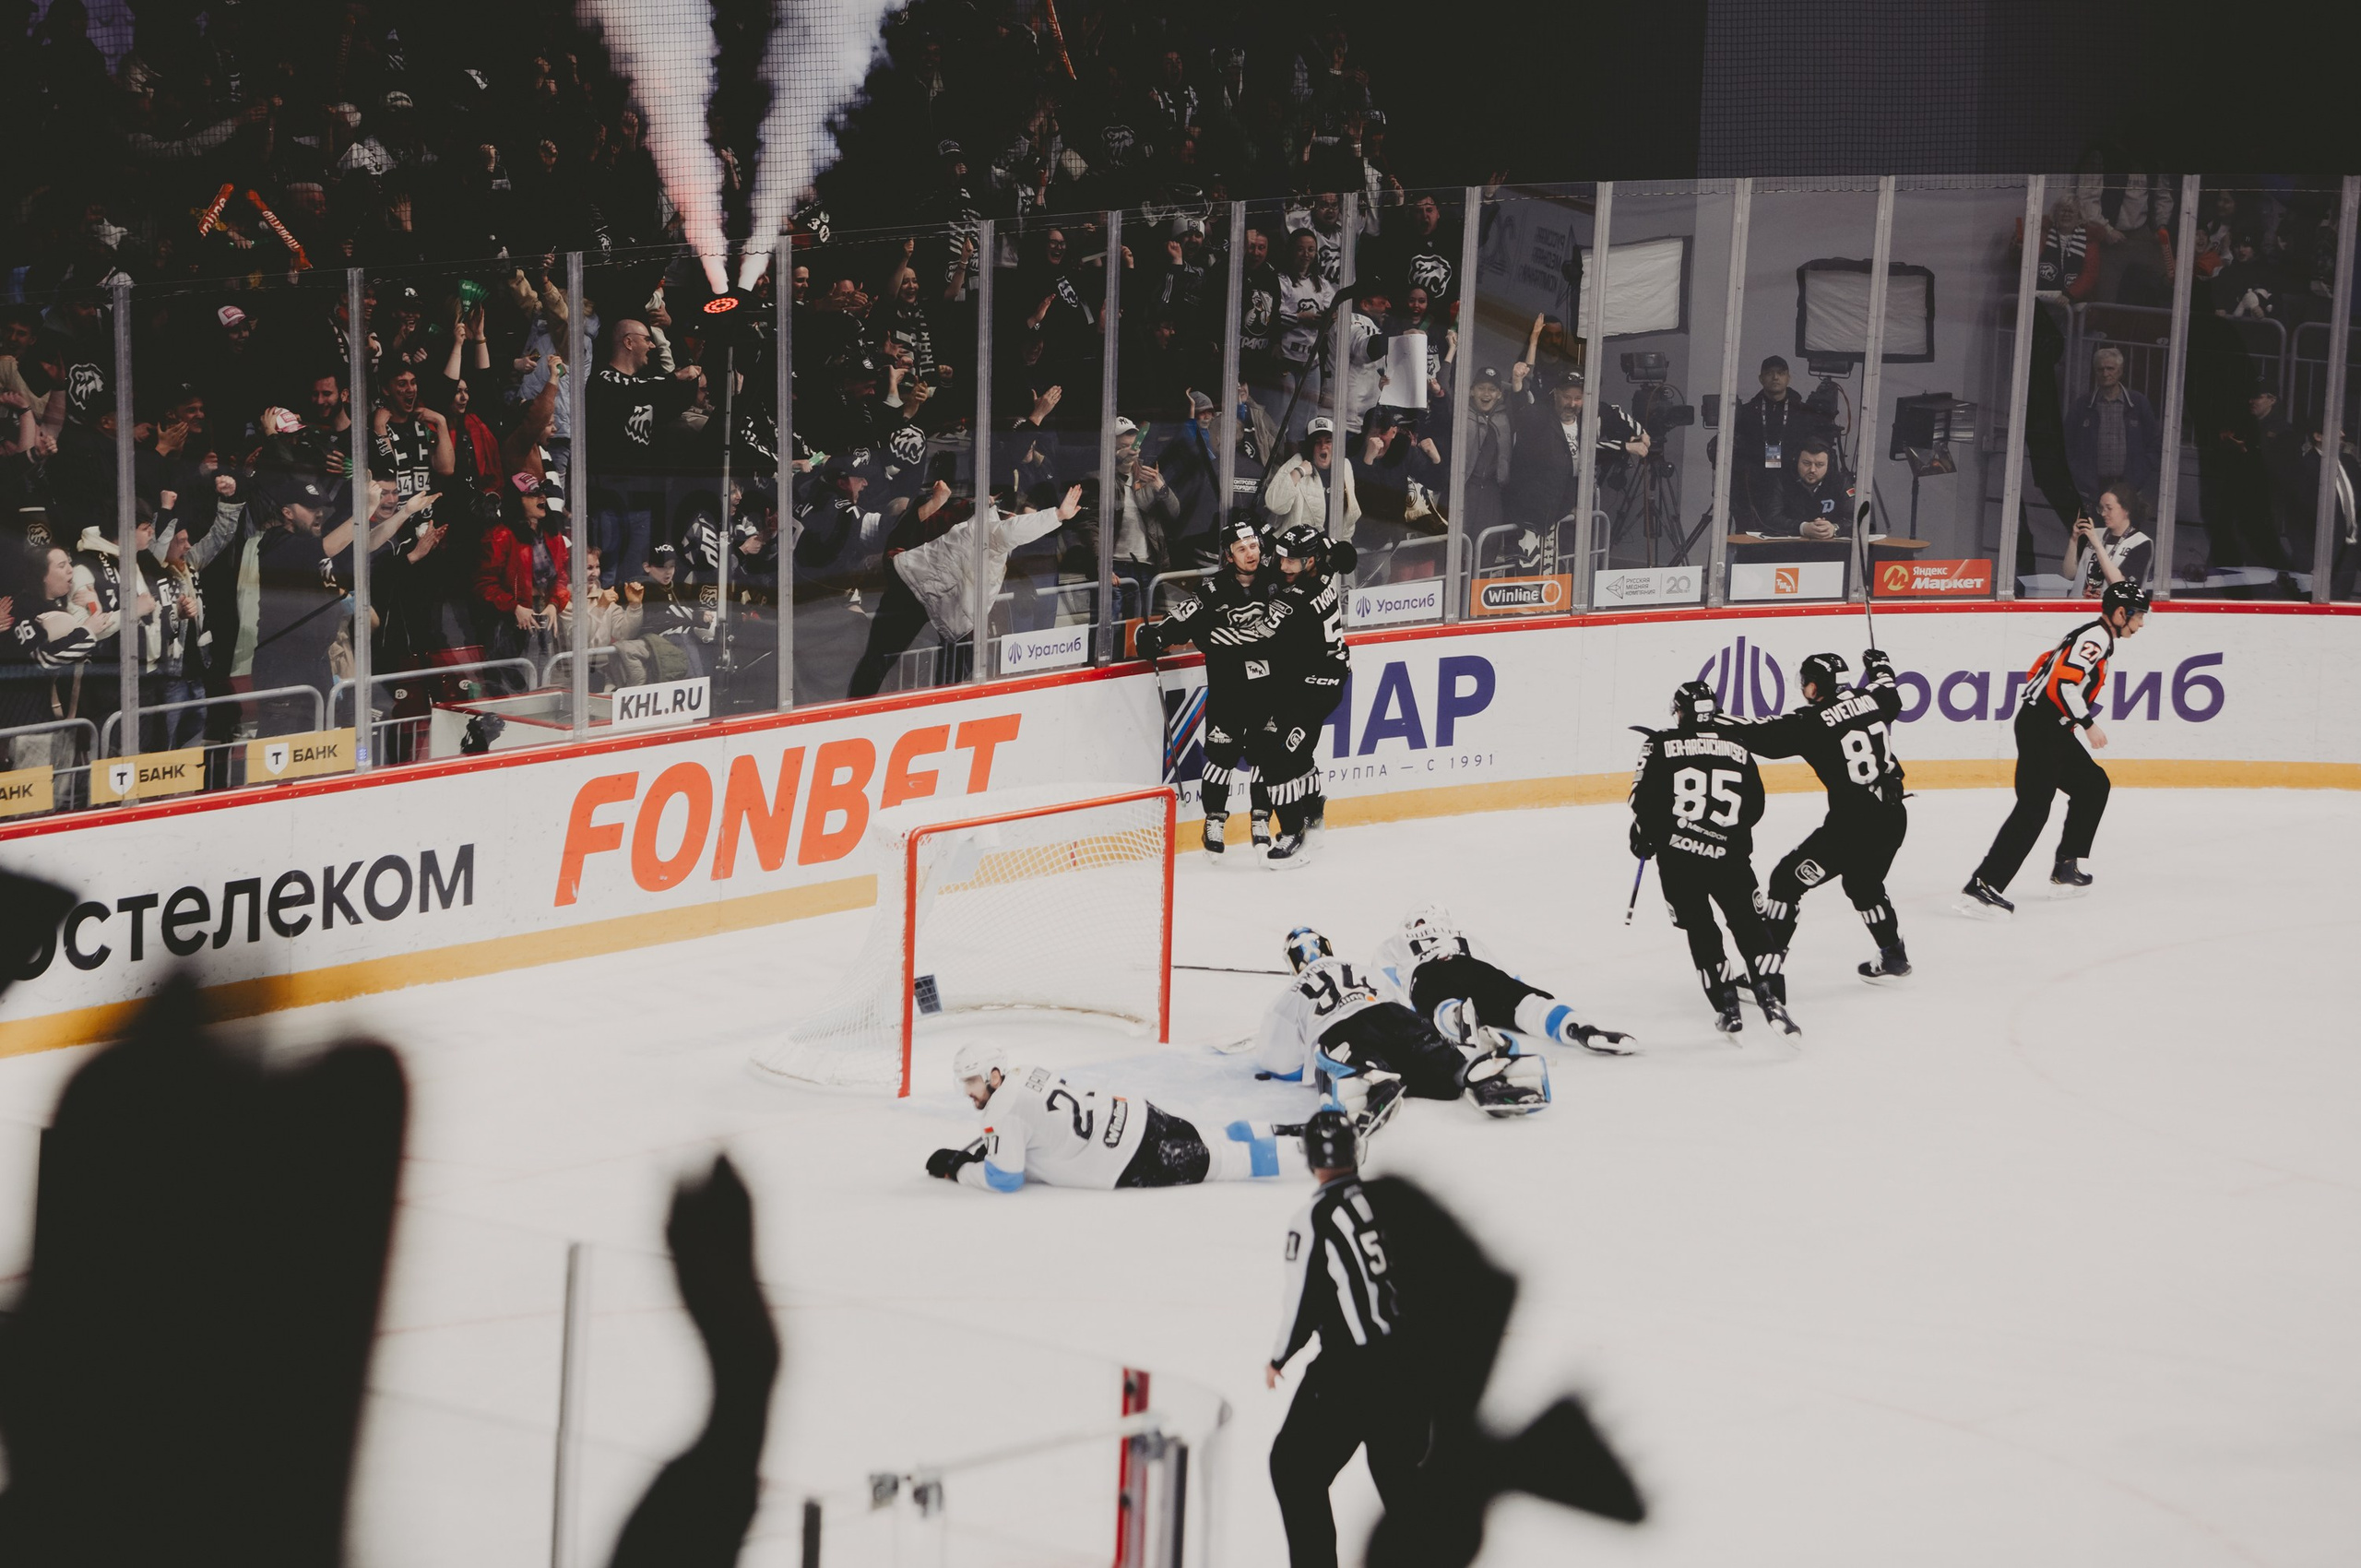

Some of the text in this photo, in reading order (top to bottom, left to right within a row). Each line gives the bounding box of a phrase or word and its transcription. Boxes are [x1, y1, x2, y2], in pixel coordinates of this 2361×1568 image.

[1913, 566, 1948, 576] Яндекс
[1911, 577, 1984, 591] Маркет
[1376, 593, 1435, 614] Уралсиб
[1488, 587, 1539, 603] Winline
[1026, 636, 1082, 660] Уралсиб
[2080, 641, 2102, 663] 27
[1304, 674, 1340, 686] CCM
[619, 685, 704, 721] KHL.RU
[292, 743, 338, 763] БАНК
[1450, 754, 1494, 769] 1991
[1840, 720, 1896, 785] 87
[138, 765, 185, 783] БАНК
[1672, 766, 1742, 827] 85
[554, 713, 1022, 907] FONBET
